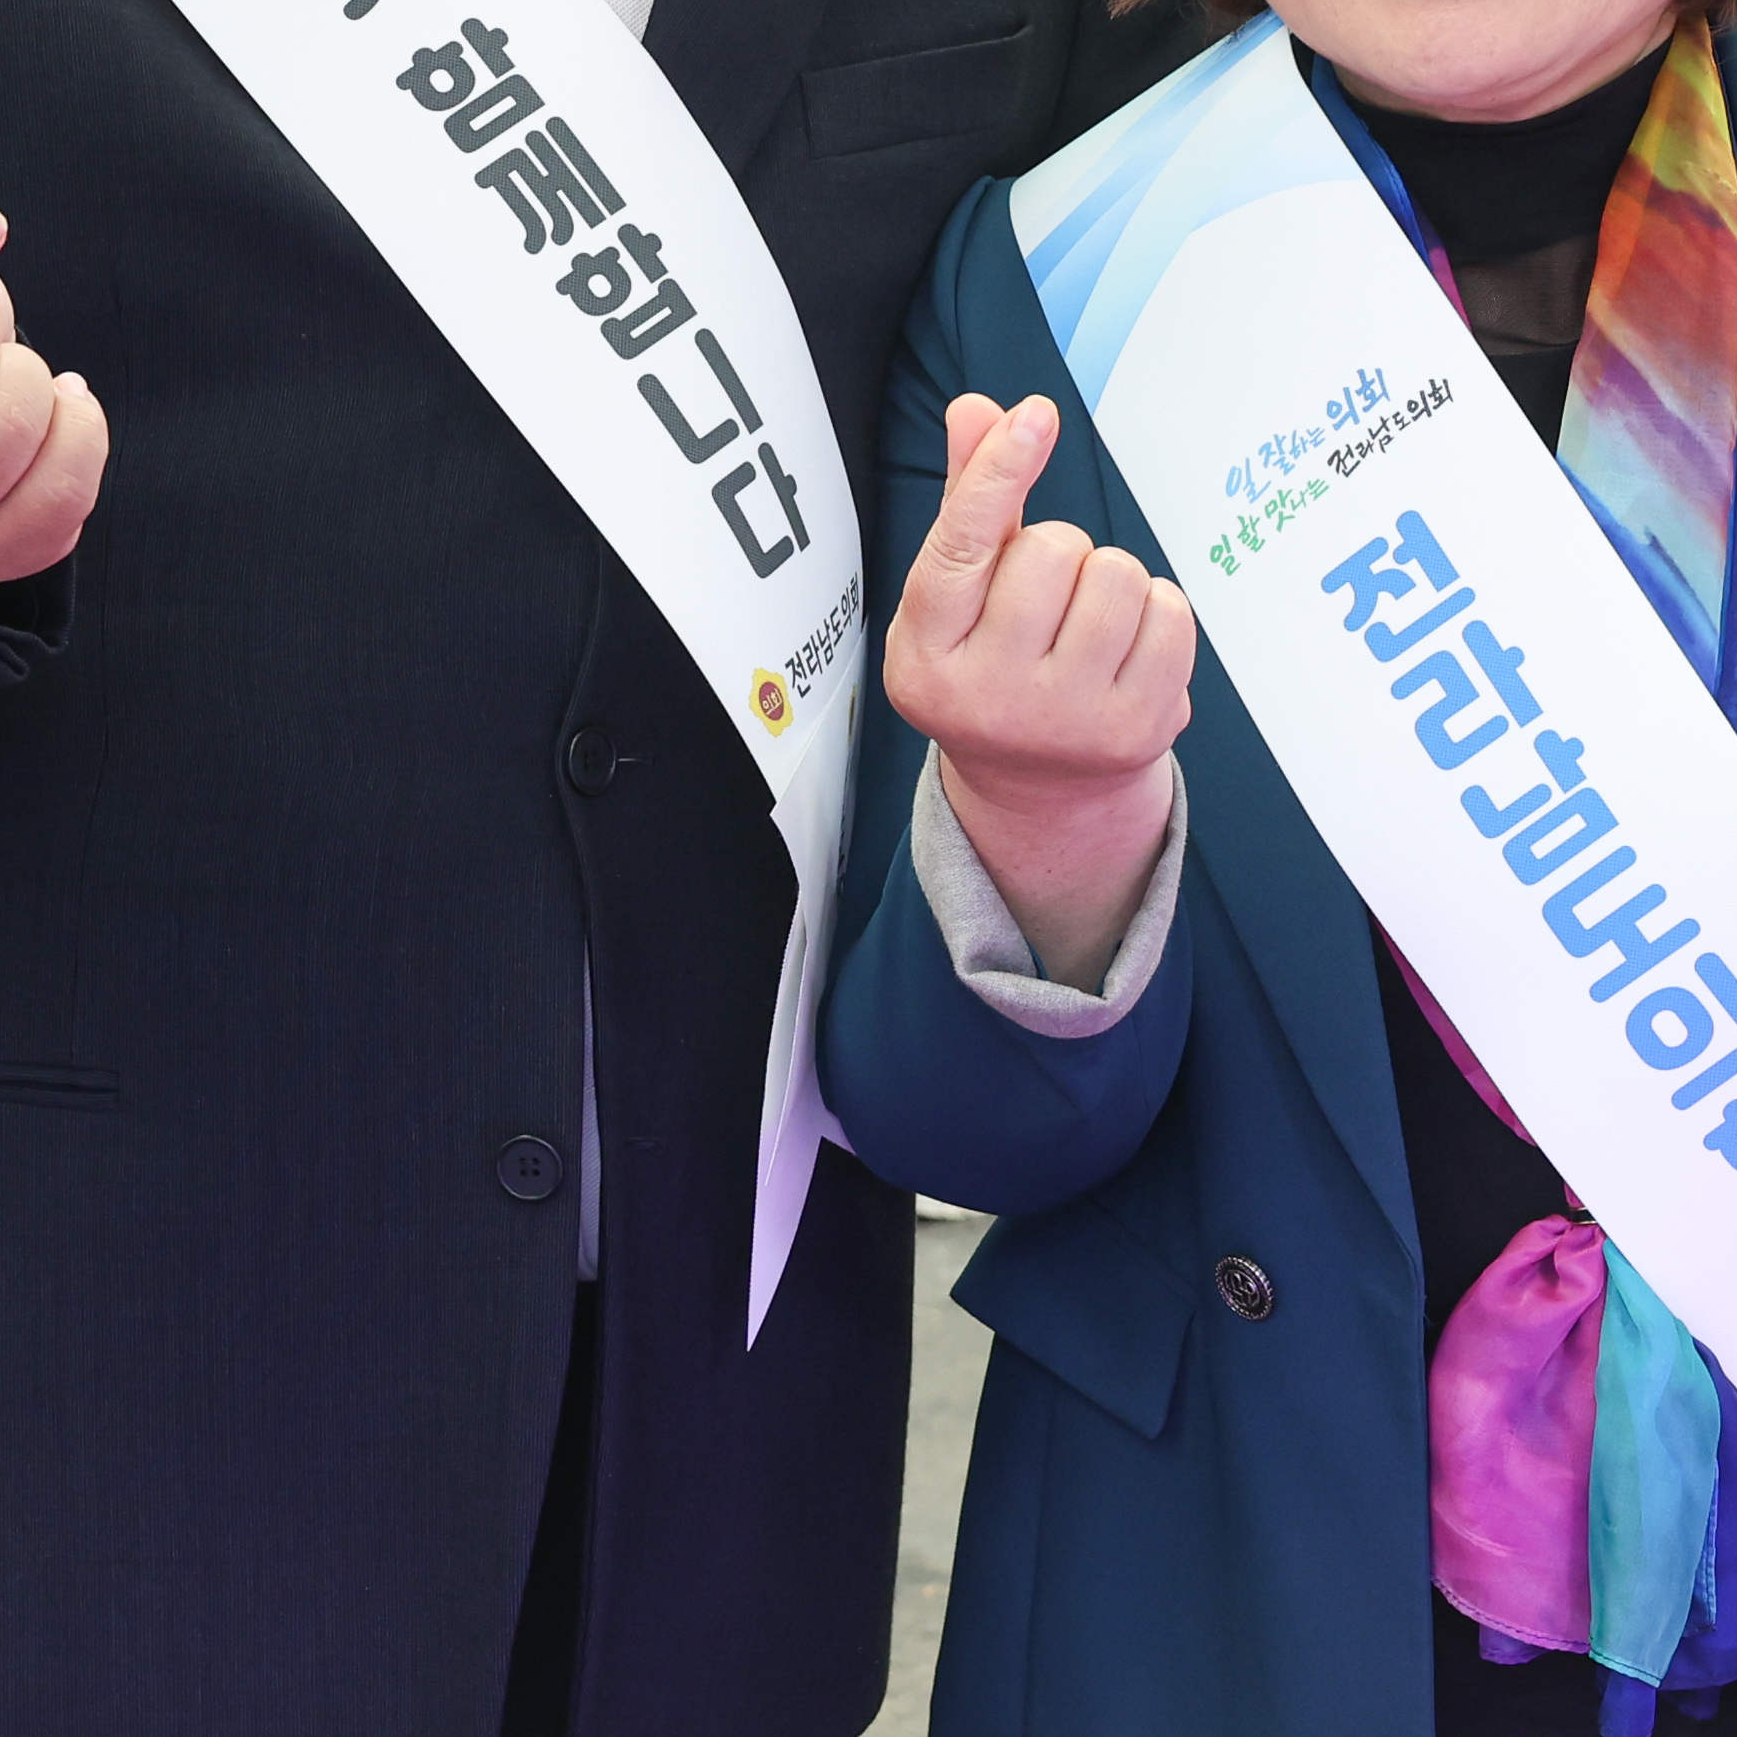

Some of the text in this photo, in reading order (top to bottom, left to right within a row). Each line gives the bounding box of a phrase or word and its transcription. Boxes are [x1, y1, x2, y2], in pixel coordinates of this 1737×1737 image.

[395, 17, 811, 579] 함께합니다
[1224, 367, 1391, 504] 일 잘하는 의회
[1326, 377, 1455, 478] 전라남도의회
[784, 570, 860, 699] 전라남도의회
